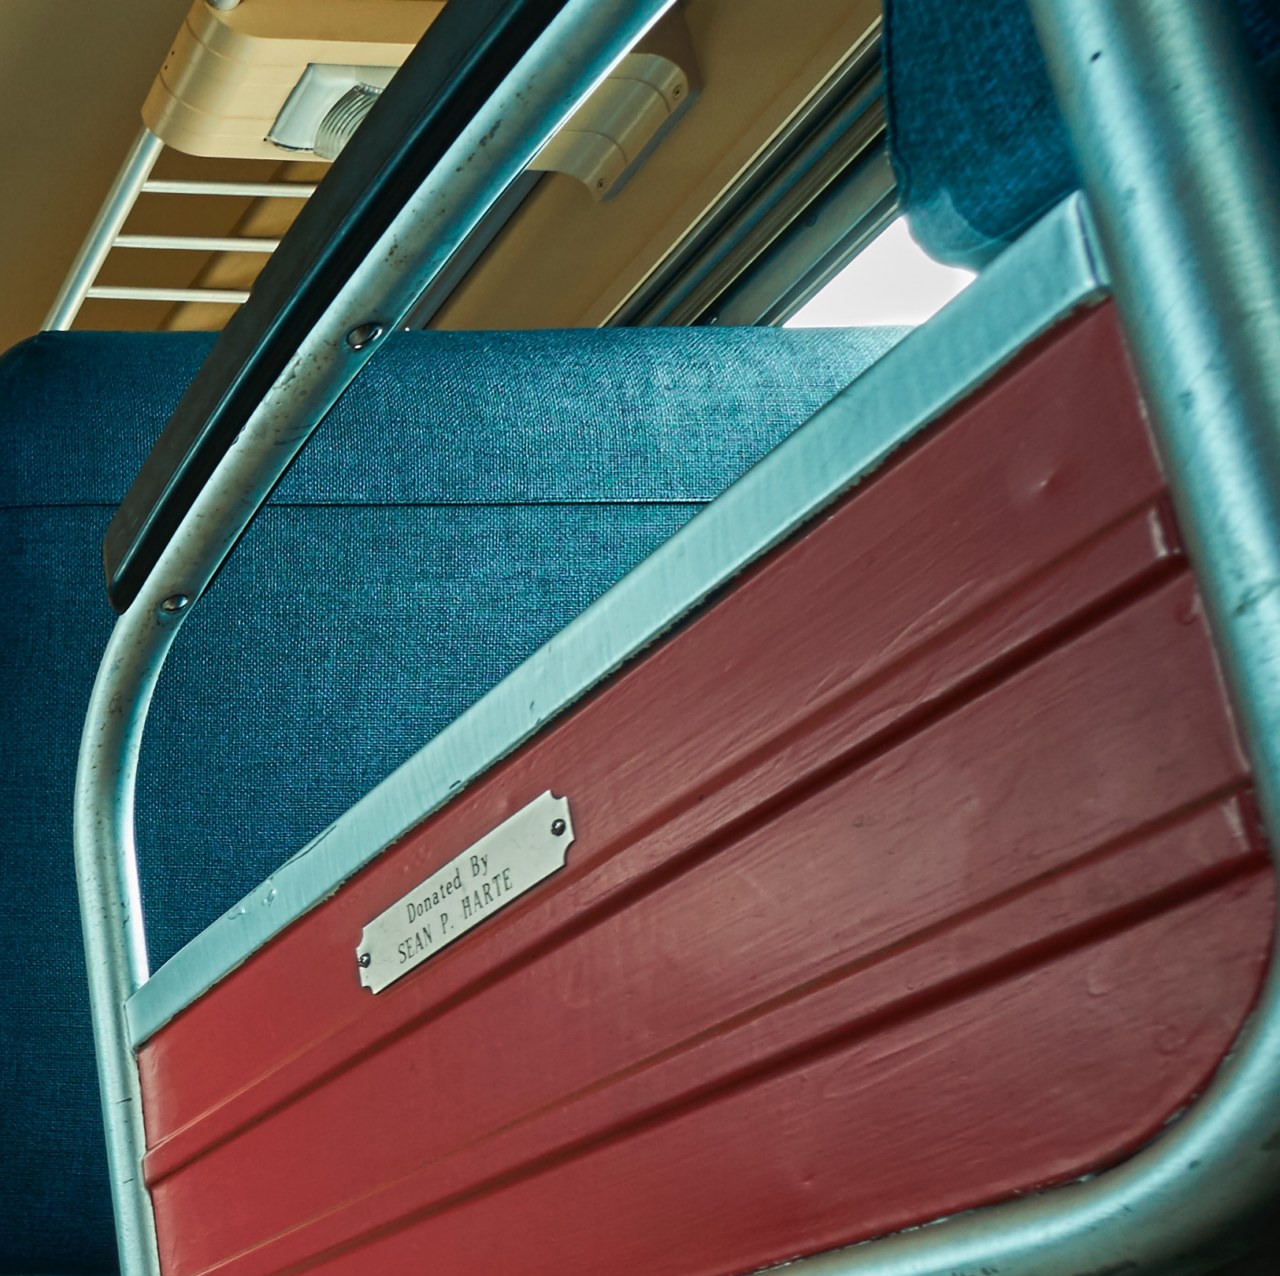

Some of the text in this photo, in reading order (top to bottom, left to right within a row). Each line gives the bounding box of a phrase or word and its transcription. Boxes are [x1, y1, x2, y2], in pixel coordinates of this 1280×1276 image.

[397, 867, 513, 964] SEAN P. HARTE
[406, 854, 489, 924] Donated By
